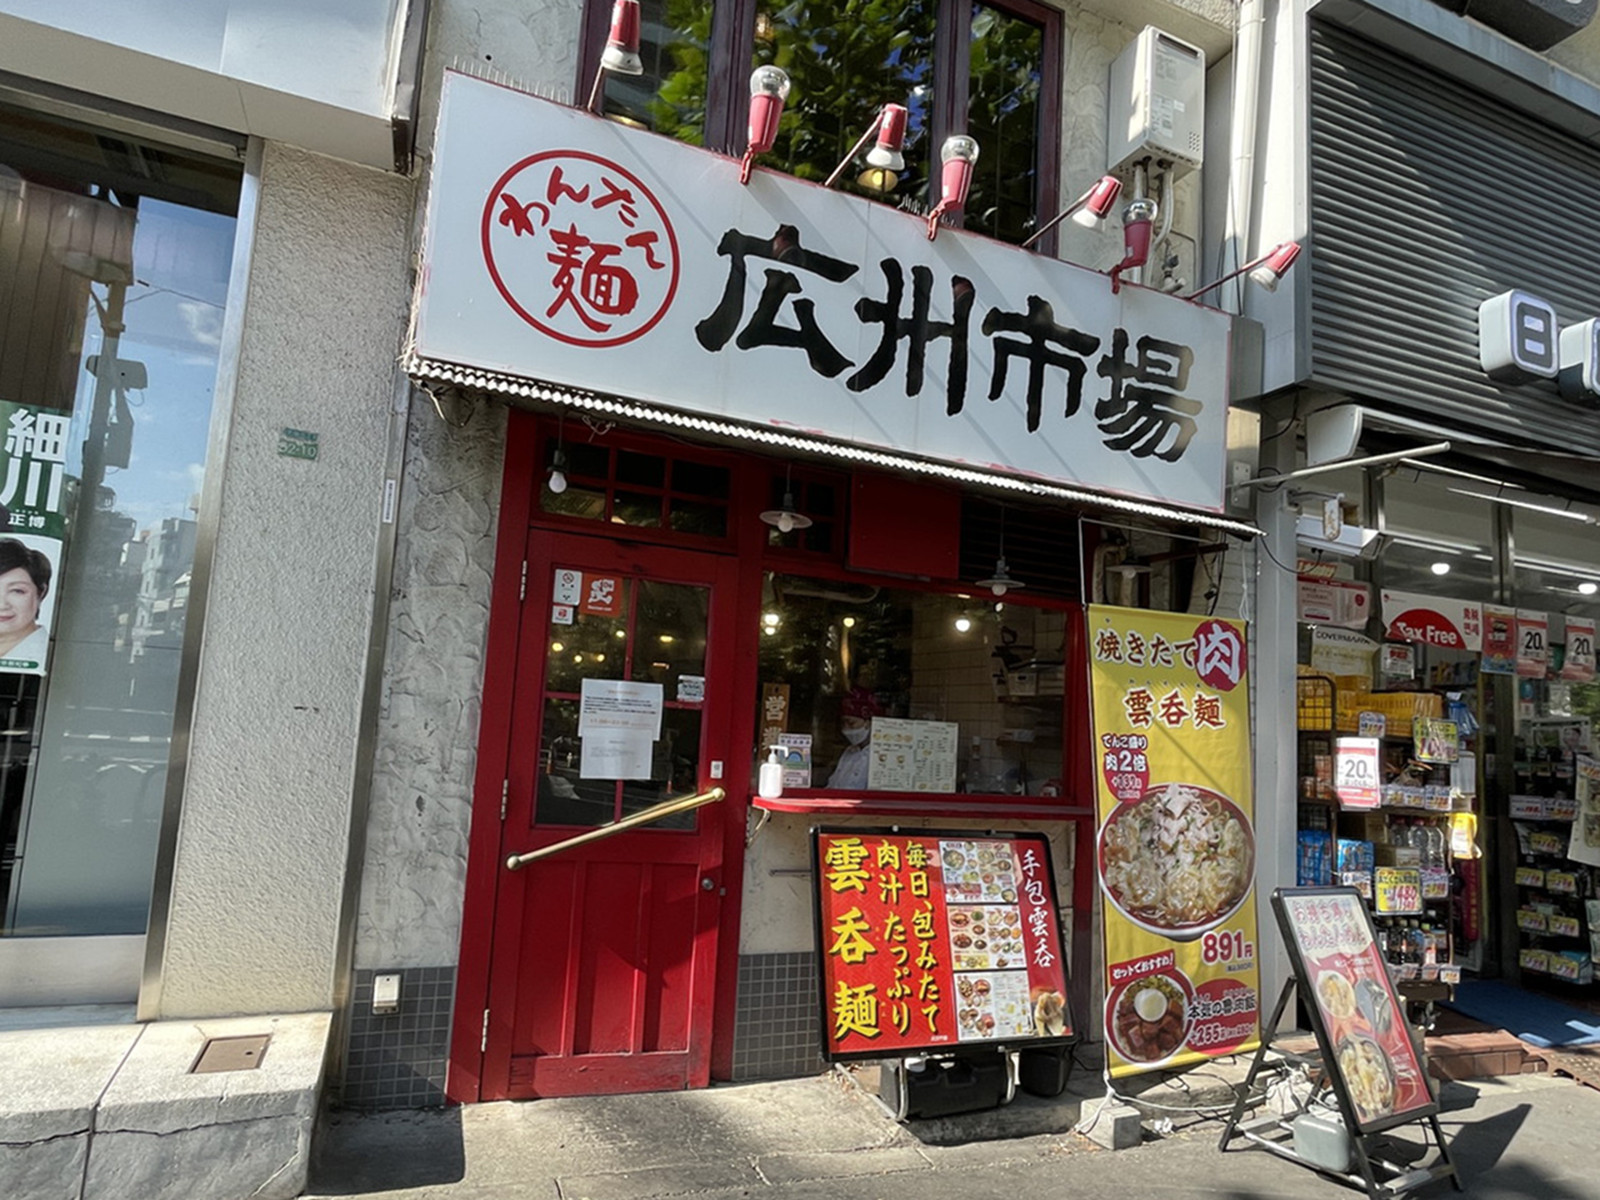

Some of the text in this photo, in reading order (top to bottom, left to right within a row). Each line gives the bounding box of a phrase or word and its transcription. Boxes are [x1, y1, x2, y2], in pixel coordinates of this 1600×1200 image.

[695, 224, 1203, 462] 広州市場
[0, 407, 71, 513] 細川
[8, 512, 45, 529] 正博
[1096, 622, 1241, 684] 焼きたて 肉
[1396, 622, 1457, 645] Tax Free
[1123, 687, 1226, 729] 雲呑麺
[825, 837, 881, 1039] 雲呑麺
[876, 839, 911, 1035] 肉汁たっぷり
[1022, 849, 1055, 968] 手包雲呑
[1202, 930, 1253, 964] 891円
